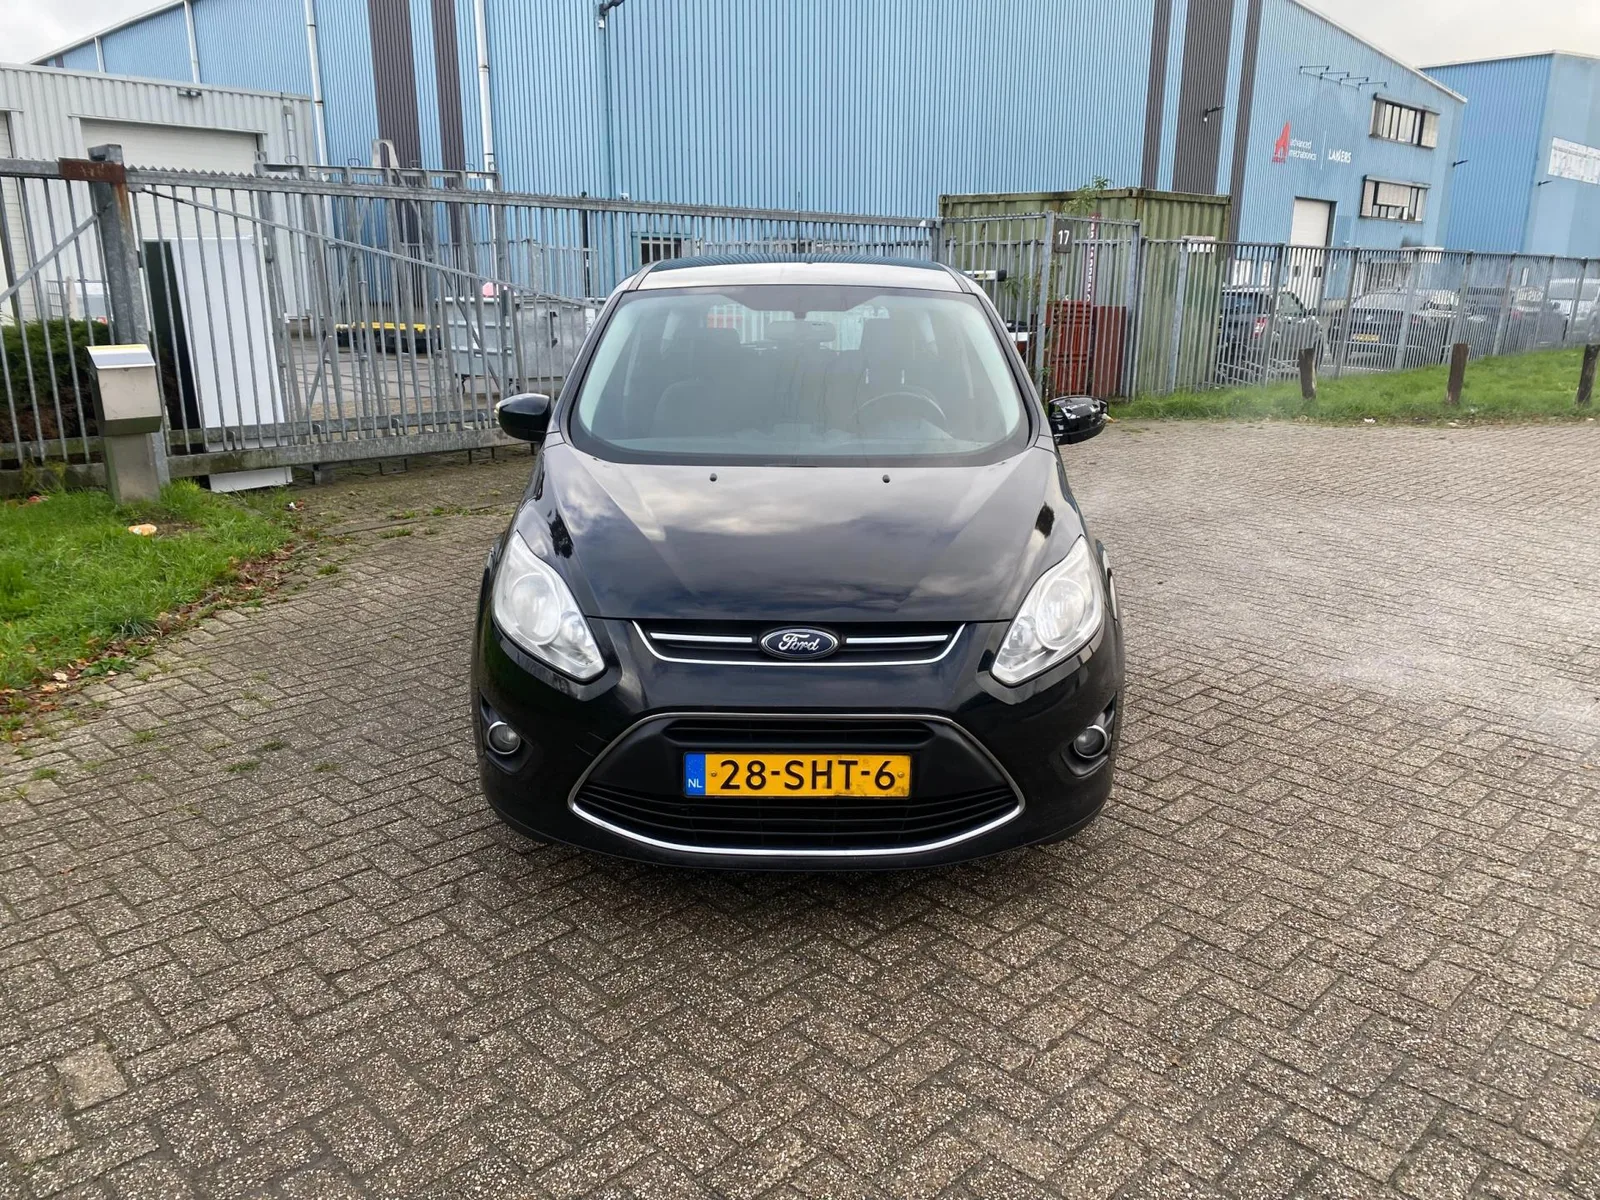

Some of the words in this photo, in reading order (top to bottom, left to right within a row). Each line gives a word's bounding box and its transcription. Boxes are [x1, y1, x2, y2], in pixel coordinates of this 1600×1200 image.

[1058, 229, 1070, 246] 17
[778, 632, 819, 651] Ford
[688, 778, 703, 788] NL
[720, 759, 896, 791] 28-SHT-6
